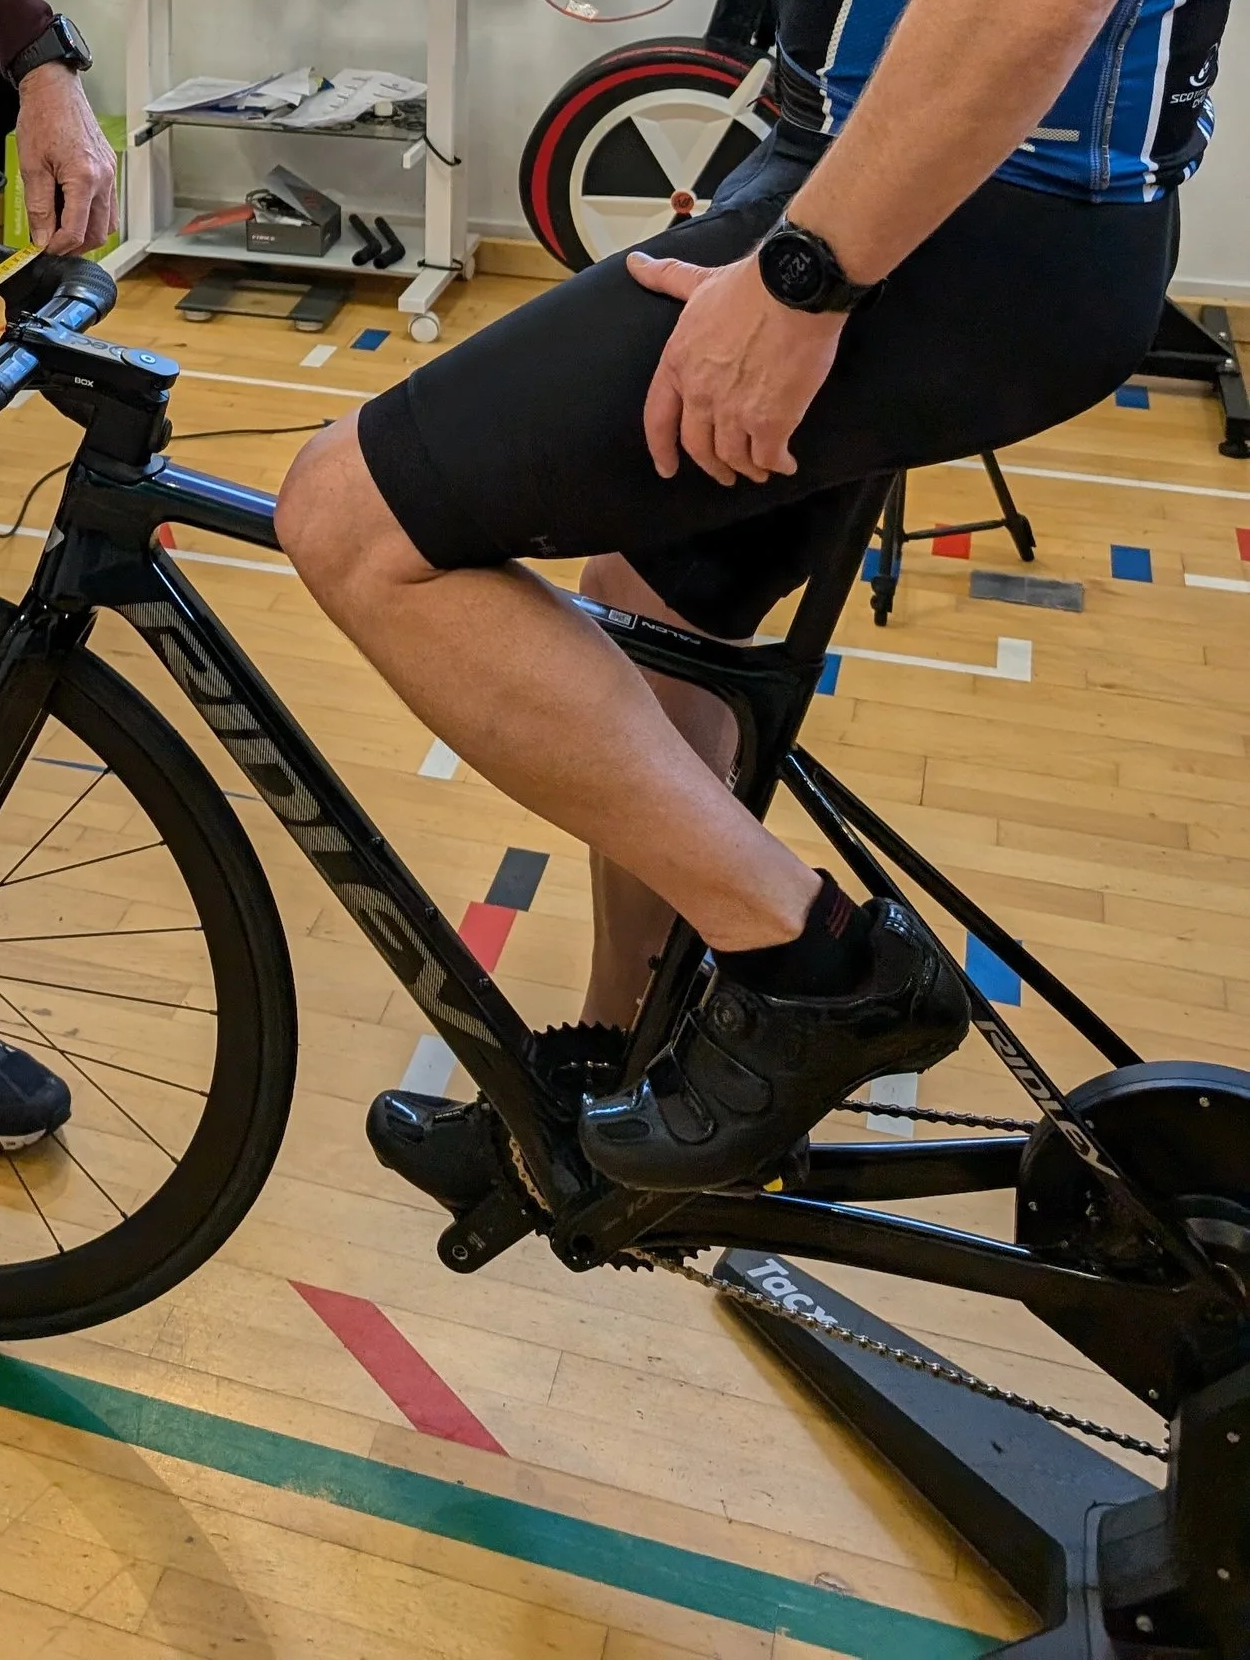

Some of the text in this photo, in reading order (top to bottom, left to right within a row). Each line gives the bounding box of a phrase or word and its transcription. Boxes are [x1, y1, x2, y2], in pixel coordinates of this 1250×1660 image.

[74, 376, 94, 388] BOX
[114, 601, 501, 1048] RIDLEY
[974, 1020, 1120, 1179] RIDLEY
[747, 1258, 838, 1325] Tacx
